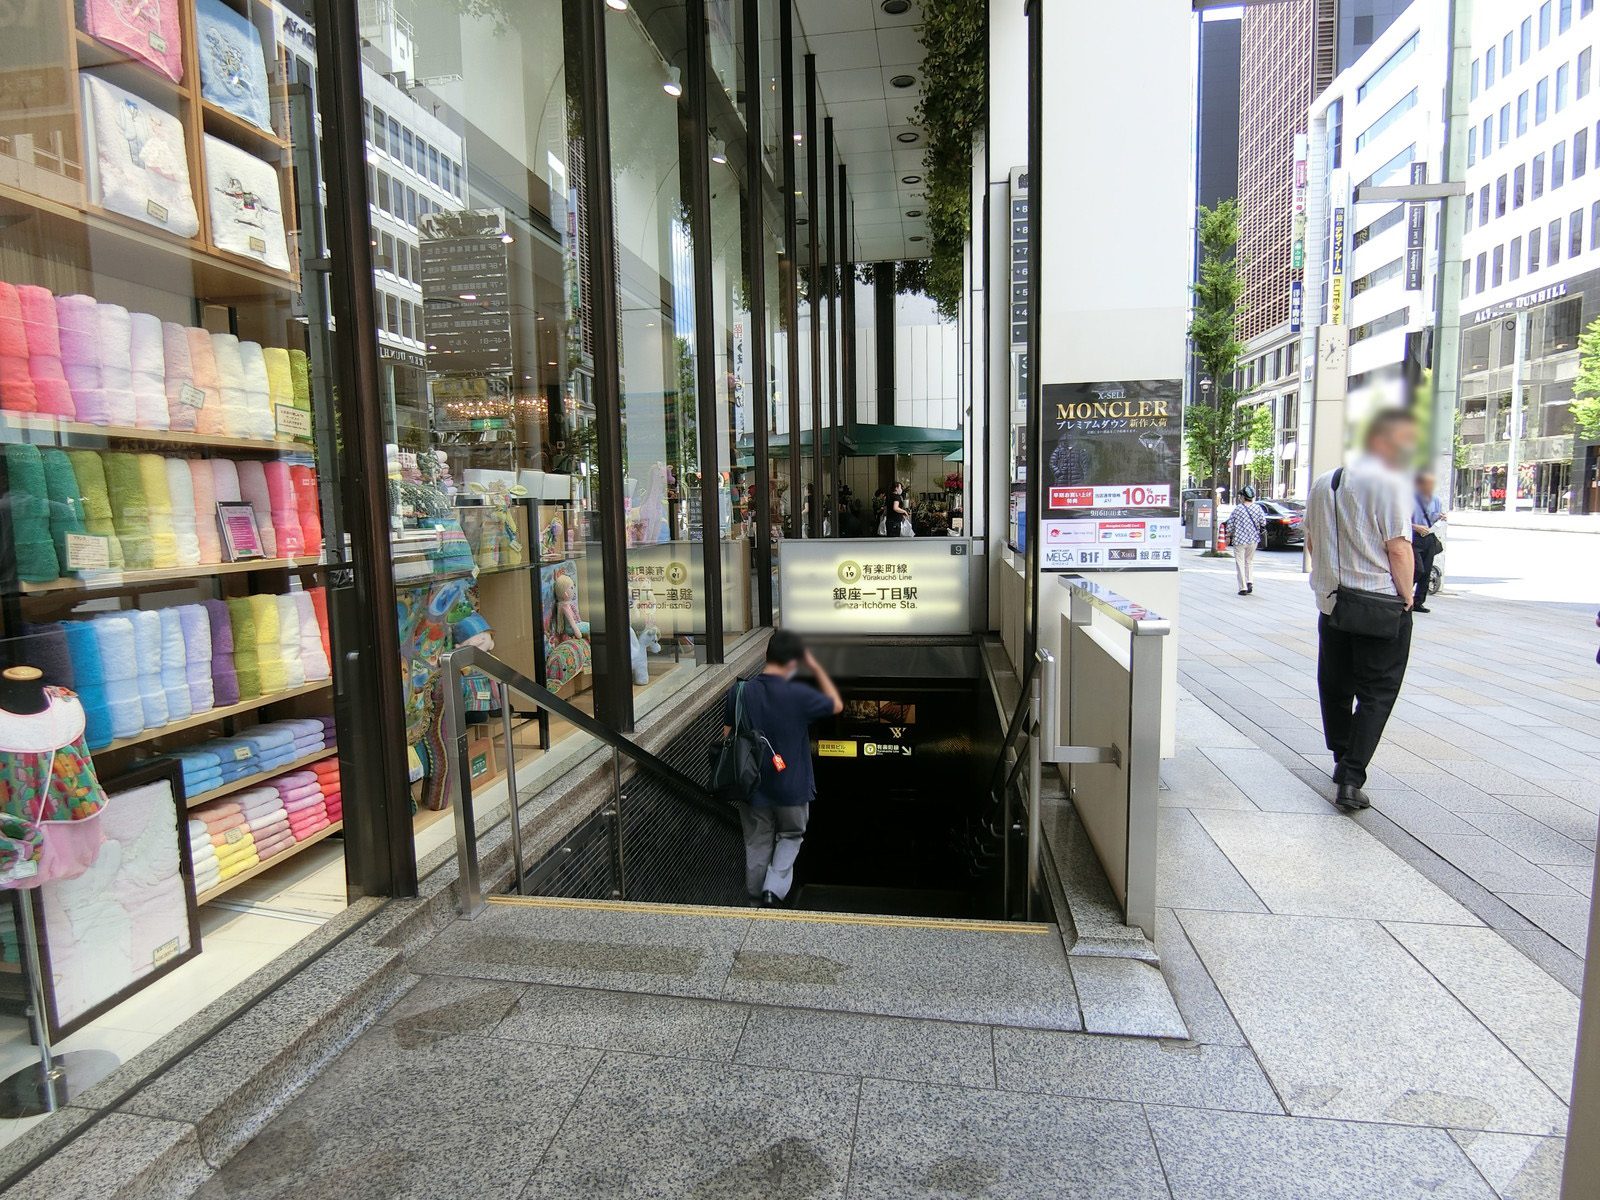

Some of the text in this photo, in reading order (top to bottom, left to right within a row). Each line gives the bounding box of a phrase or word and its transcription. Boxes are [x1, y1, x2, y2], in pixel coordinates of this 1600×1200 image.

[1333, 279, 1341, 303] ELITE
[1516, 282, 1567, 308] DUNHILL
[1097, 391, 1126, 400] X-SELL
[1056, 400, 1169, 420] MONCLER
[1056, 419, 1128, 430] プレミアムダウン
[1146, 495, 1167, 505] OFF
[955, 545, 962, 555] 9
[1046, 552, 1074, 562] MELSA
[1080, 552, 1099, 563] B1F
[1140, 551, 1171, 560] 銀座店
[862, 564, 908, 574] 有楽町線
[833, 587, 918, 600] 銀座一丁目駅
[900, 601, 918, 609] Sta.
